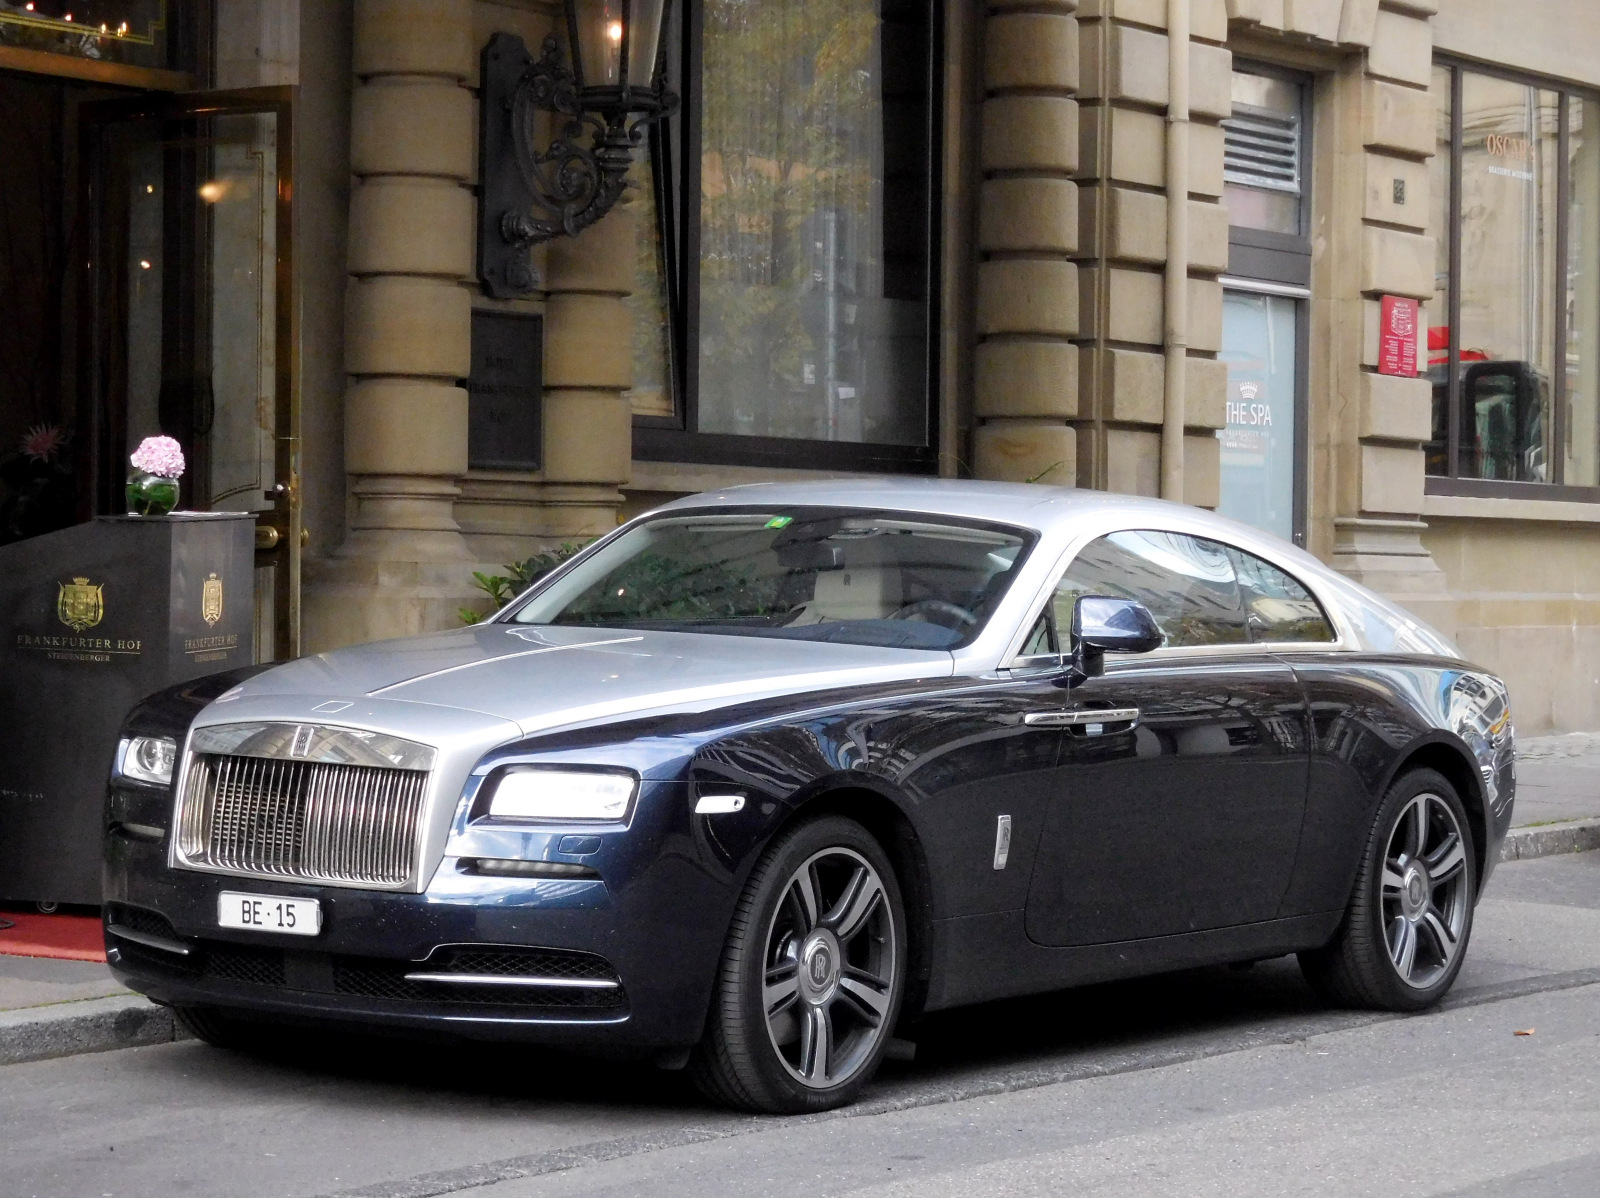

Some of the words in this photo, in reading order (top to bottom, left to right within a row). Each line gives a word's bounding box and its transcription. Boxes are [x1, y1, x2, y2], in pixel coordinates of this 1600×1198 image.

[1226, 401, 1247, 425] THE
[1250, 403, 1272, 427] SPA
[16, 634, 112, 649] FRANKFURTER
[117, 639, 142, 650] HOF
[184, 635, 225, 650] FRANKFURTER
